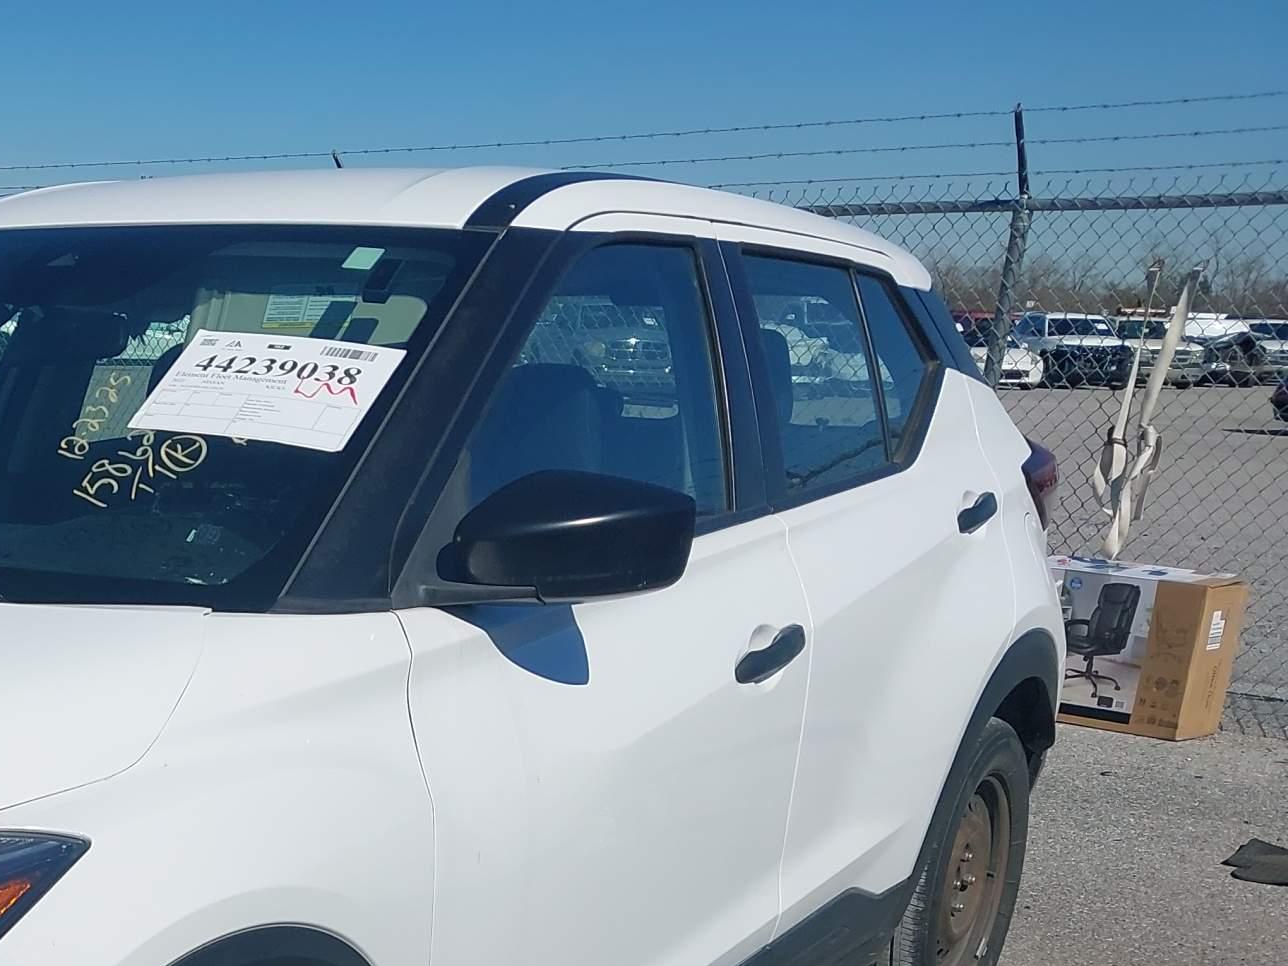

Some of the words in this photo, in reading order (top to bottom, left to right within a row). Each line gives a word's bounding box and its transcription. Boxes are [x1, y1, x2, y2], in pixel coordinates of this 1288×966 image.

[175, 371, 209, 379] Element
[233, 375, 288, 386] Management
[194, 354, 363, 386] 44239038
